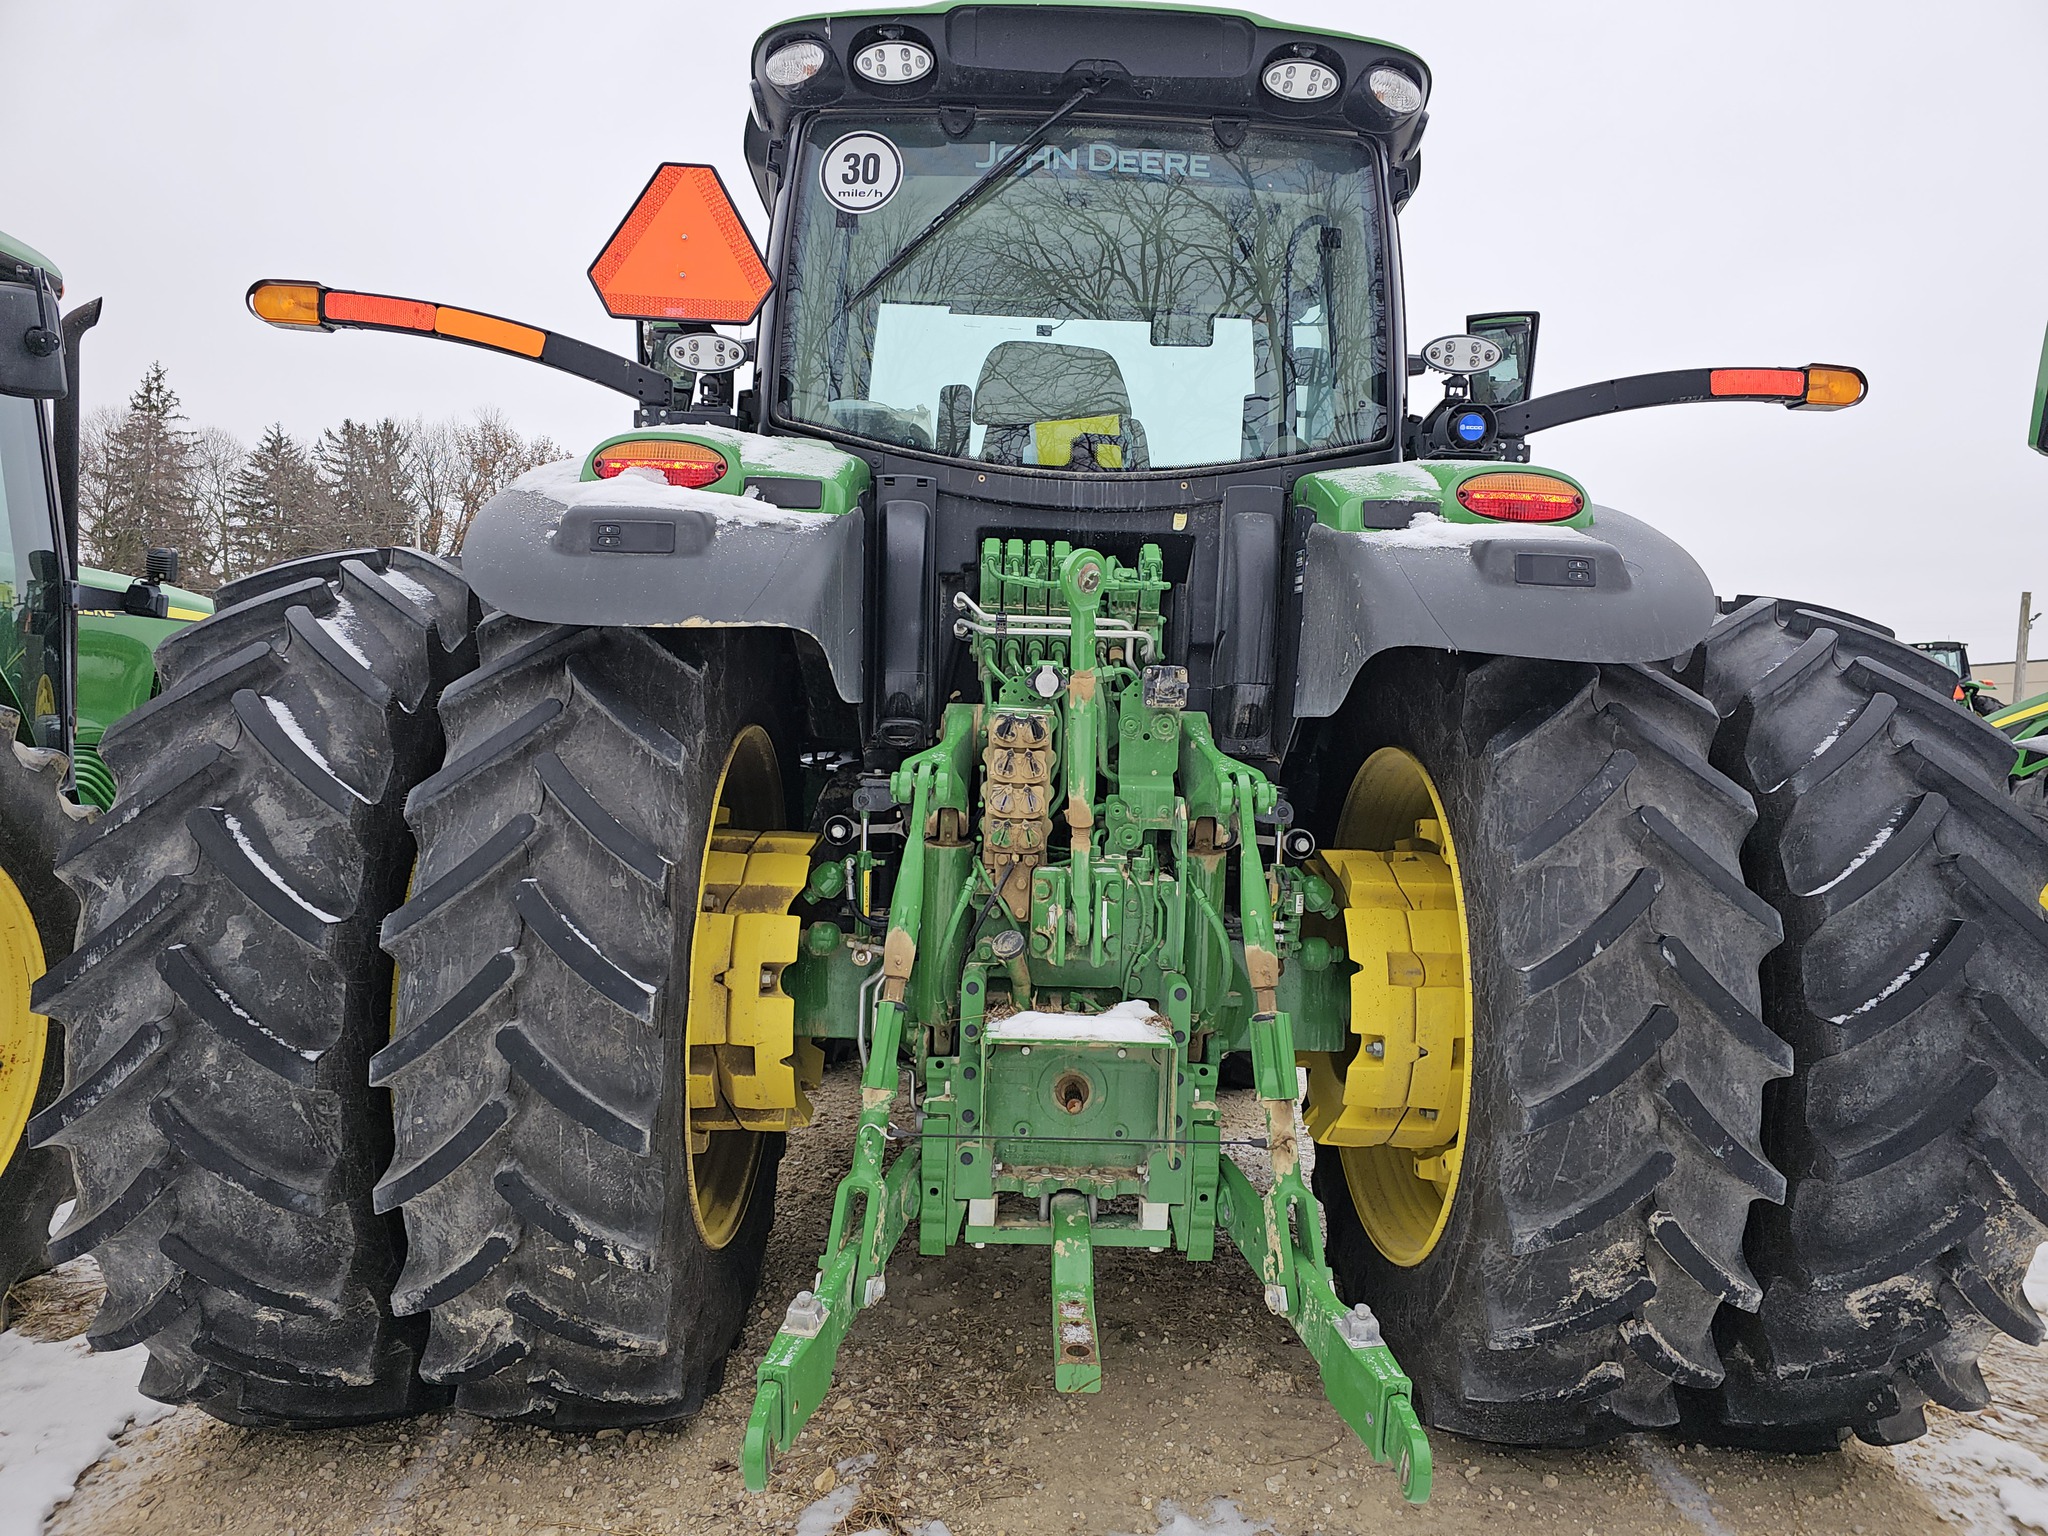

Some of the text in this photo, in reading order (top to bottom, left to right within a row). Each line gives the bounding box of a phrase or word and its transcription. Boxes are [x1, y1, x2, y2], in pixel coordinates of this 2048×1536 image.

[842, 153, 880, 184] 30
[1089, 144, 1211, 178] DEERE
[838, 189, 883, 197] mile/h
